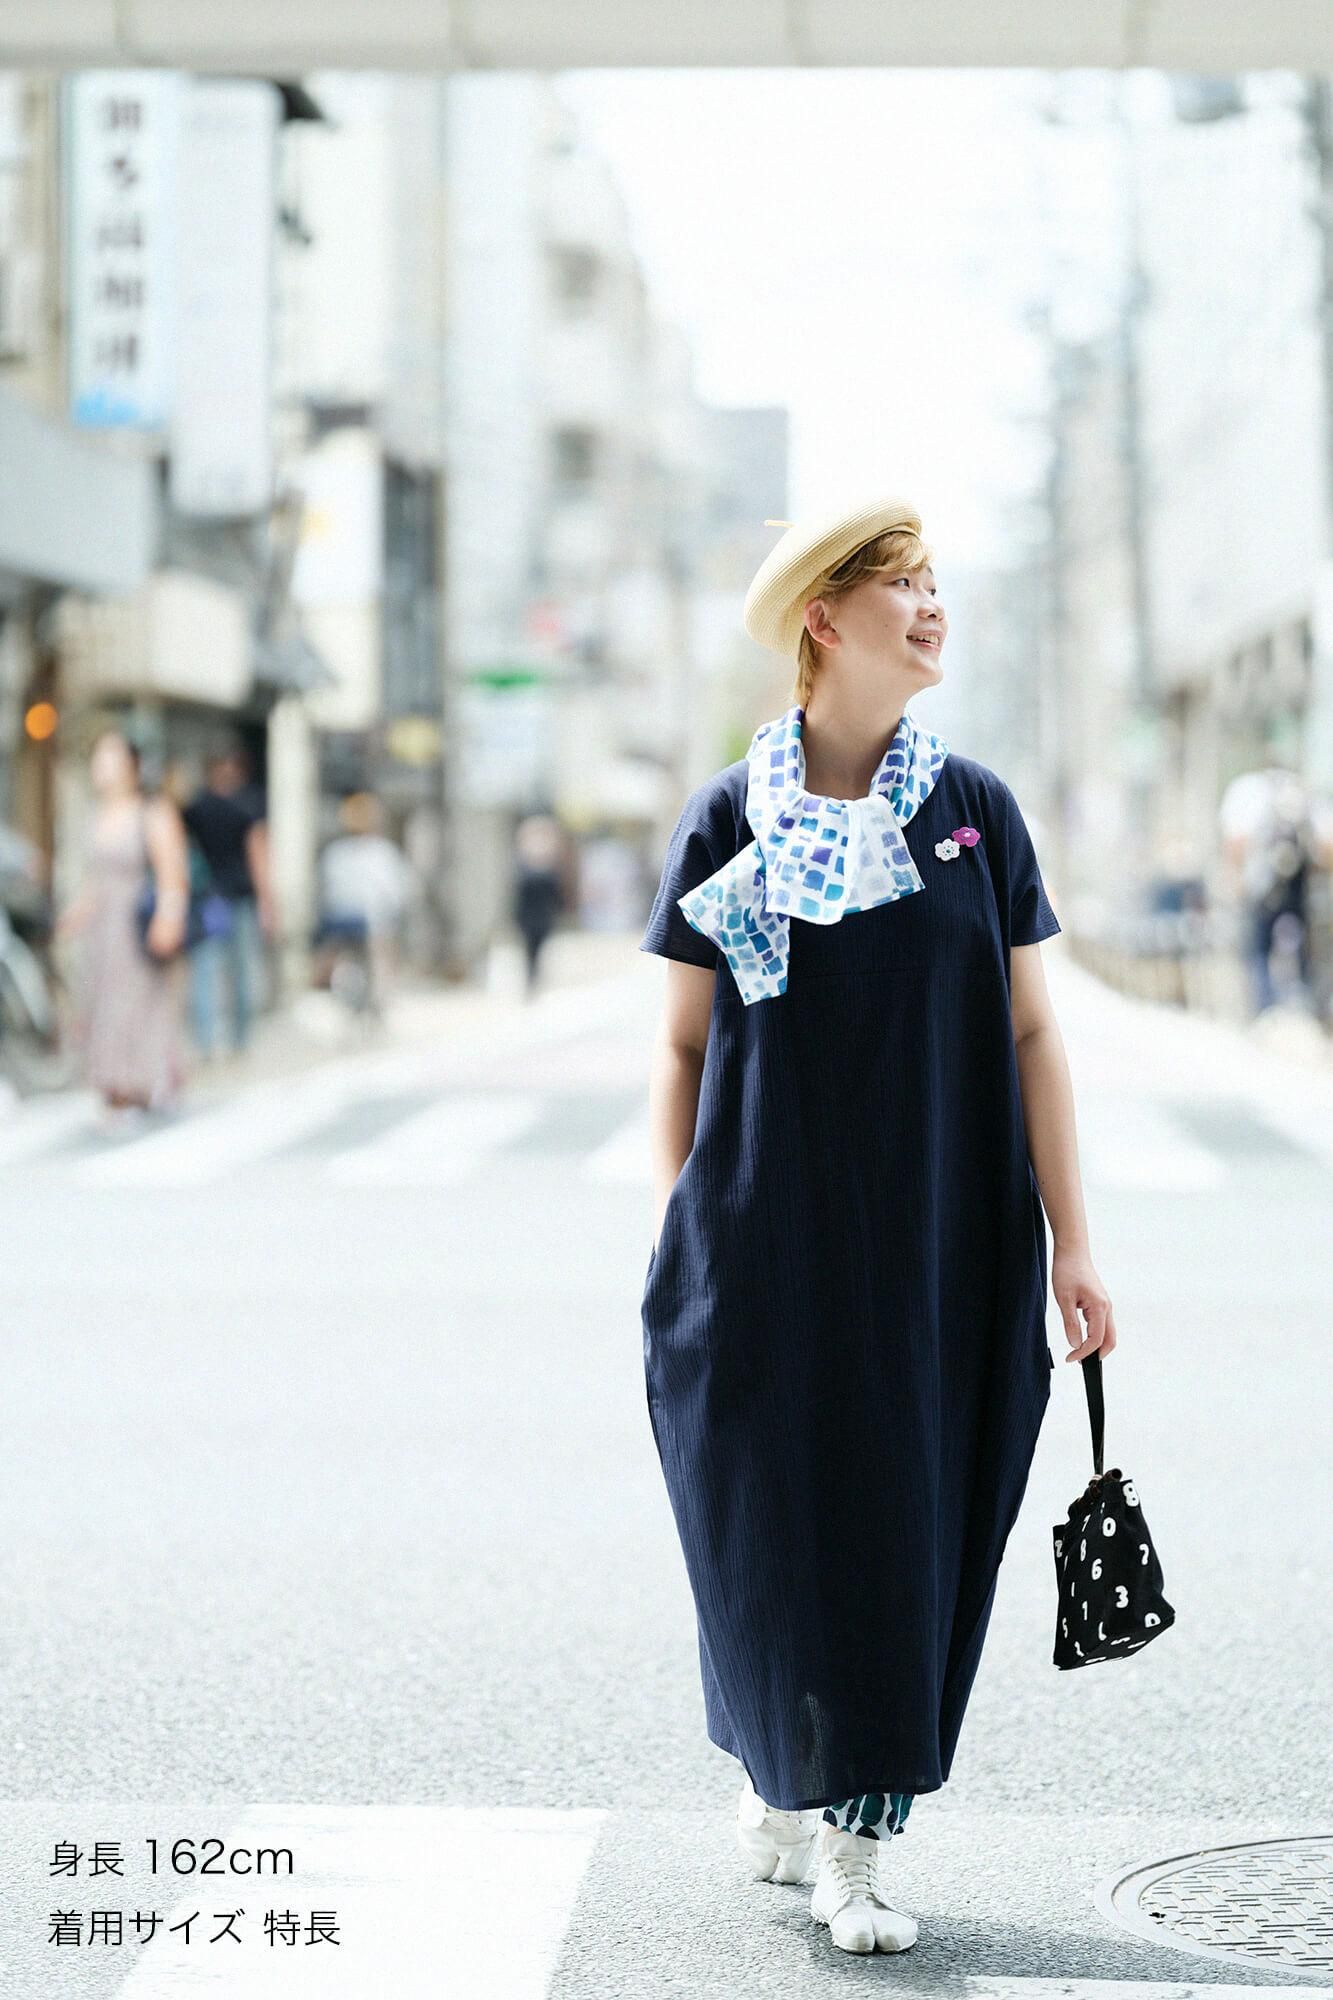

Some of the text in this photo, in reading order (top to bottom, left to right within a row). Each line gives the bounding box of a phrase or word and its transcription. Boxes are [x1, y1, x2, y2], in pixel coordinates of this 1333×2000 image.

[1123, 1482, 1140, 1507] 8
[1102, 1517, 1117, 1538] 0
[1139, 1544, 1150, 1566] 7
[1091, 1558, 1103, 1581] 6
[1115, 1585, 1129, 1609] 3
